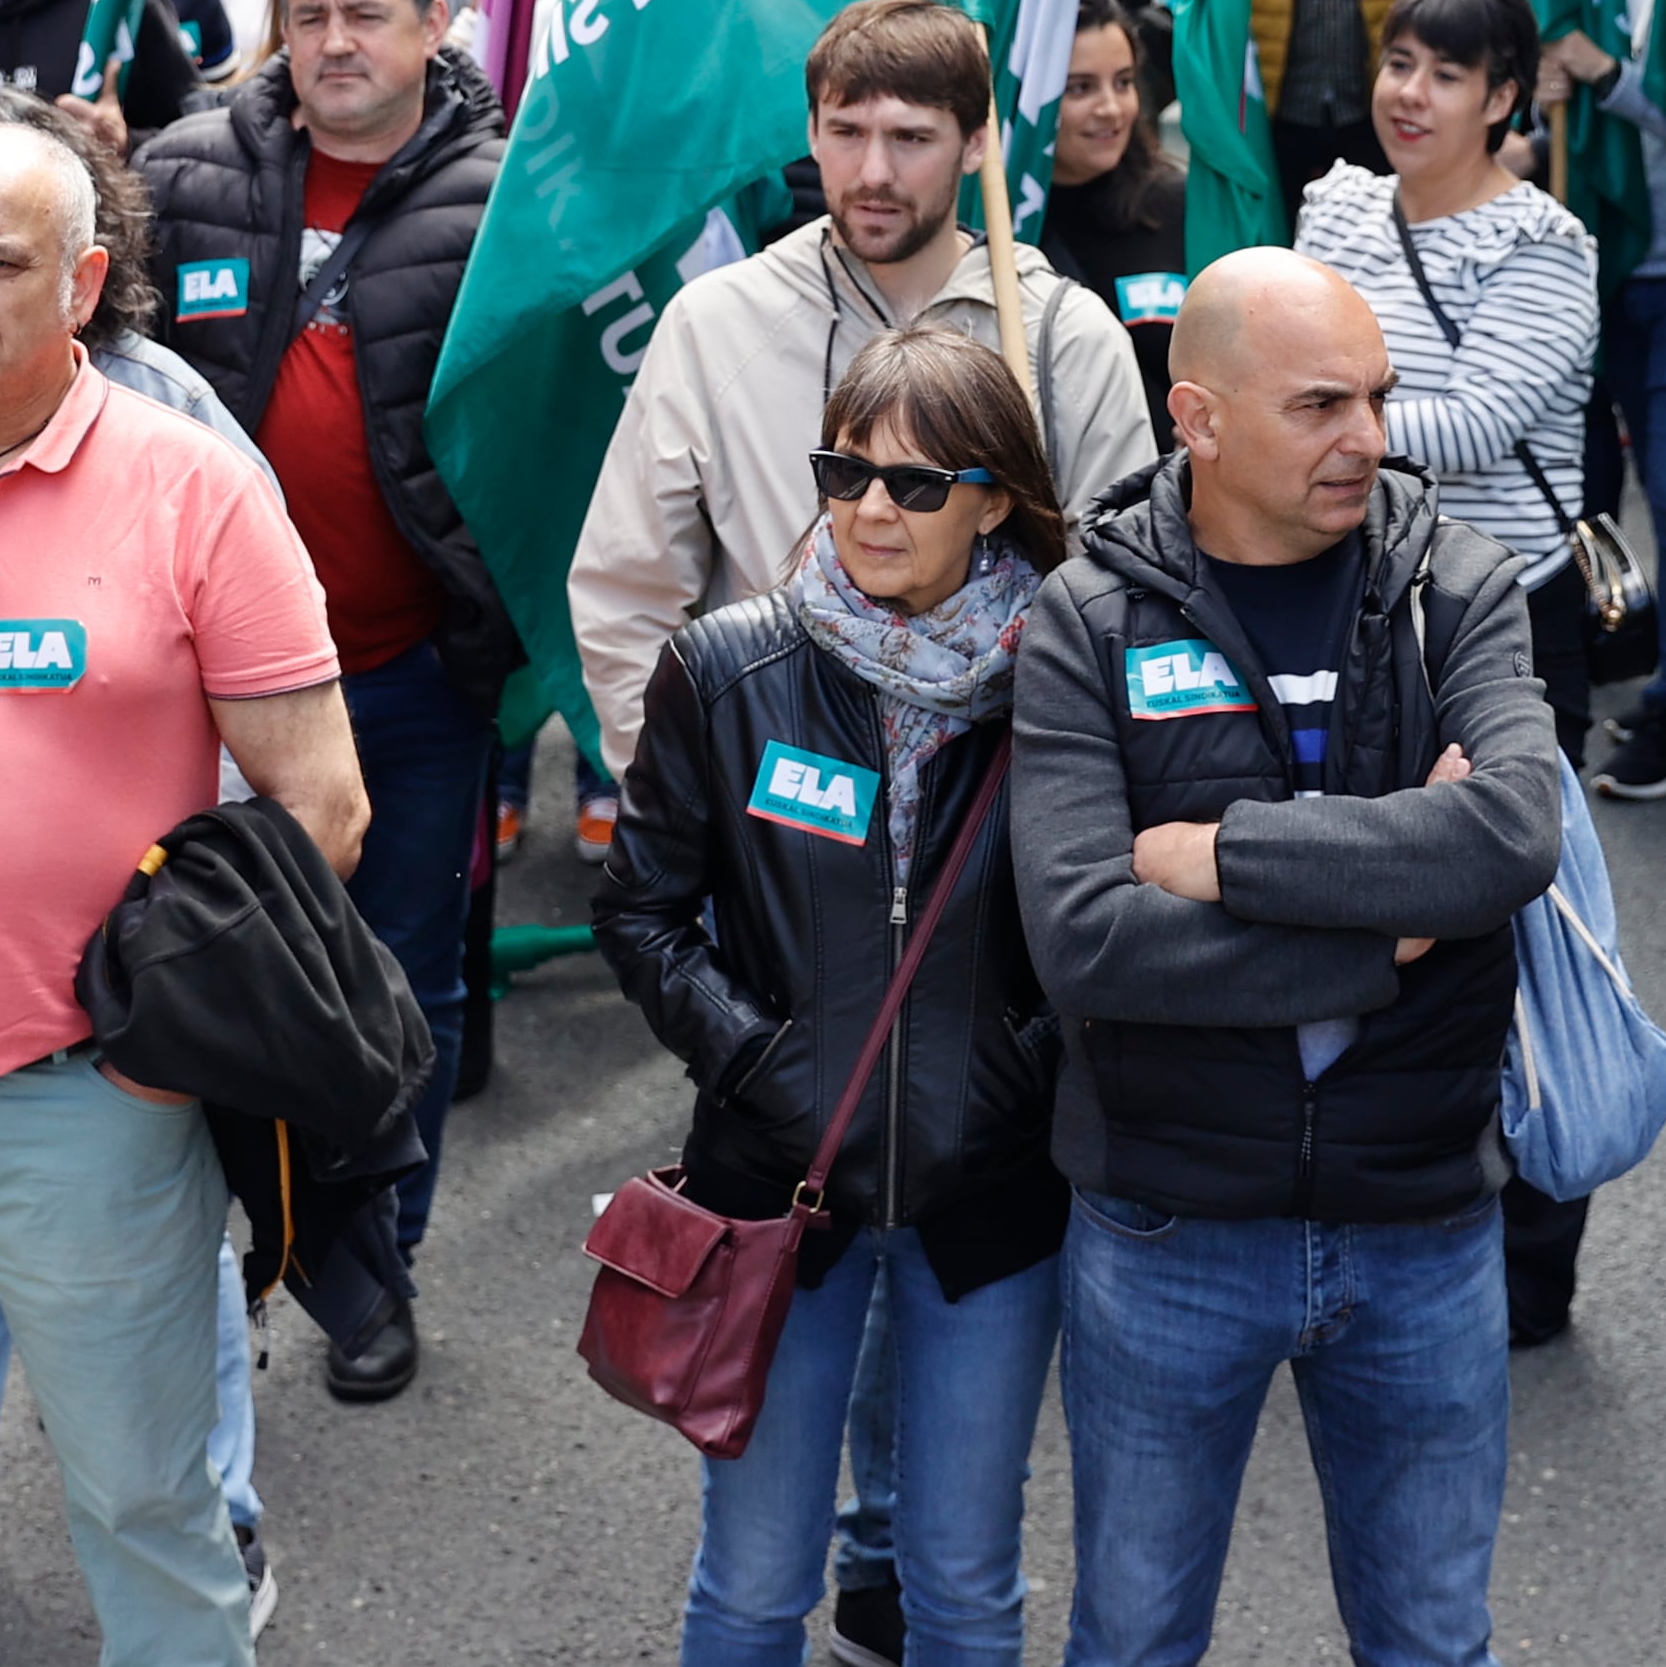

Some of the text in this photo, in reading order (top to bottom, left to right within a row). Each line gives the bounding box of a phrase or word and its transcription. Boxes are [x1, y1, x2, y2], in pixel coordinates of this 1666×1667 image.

[184, 268, 238, 302] ELA
[1141, 652, 1239, 697] ELA
[768, 757, 857, 817] ELA
